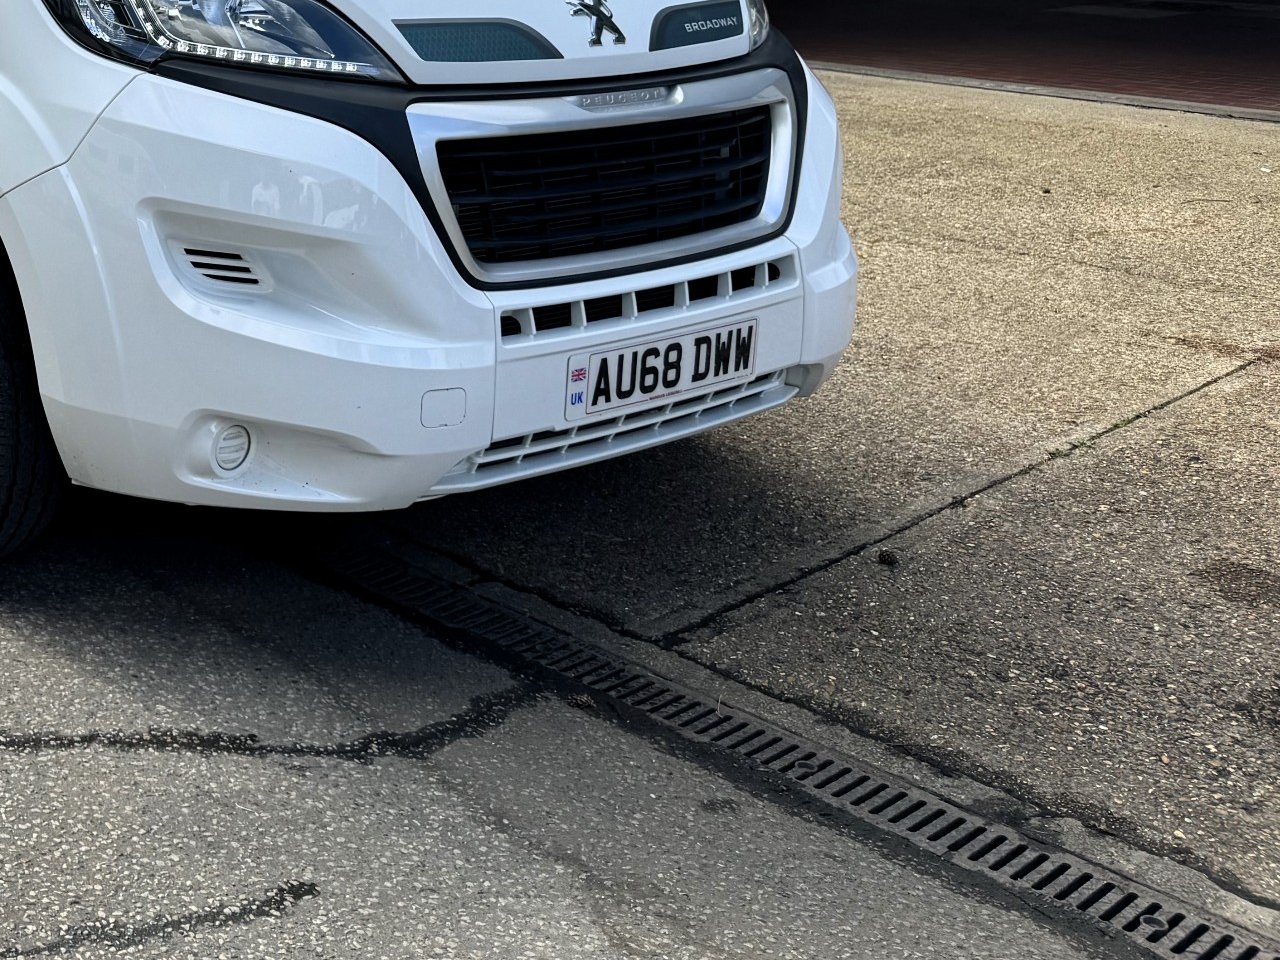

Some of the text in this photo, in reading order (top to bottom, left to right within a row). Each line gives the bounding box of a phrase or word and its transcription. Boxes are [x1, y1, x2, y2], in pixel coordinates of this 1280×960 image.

[684, 16, 738, 33] BROADWAY
[582, 89, 660, 106] PEUGEOT
[591, 325, 754, 406] AU68 DWW
[570, 391, 584, 405] UK
